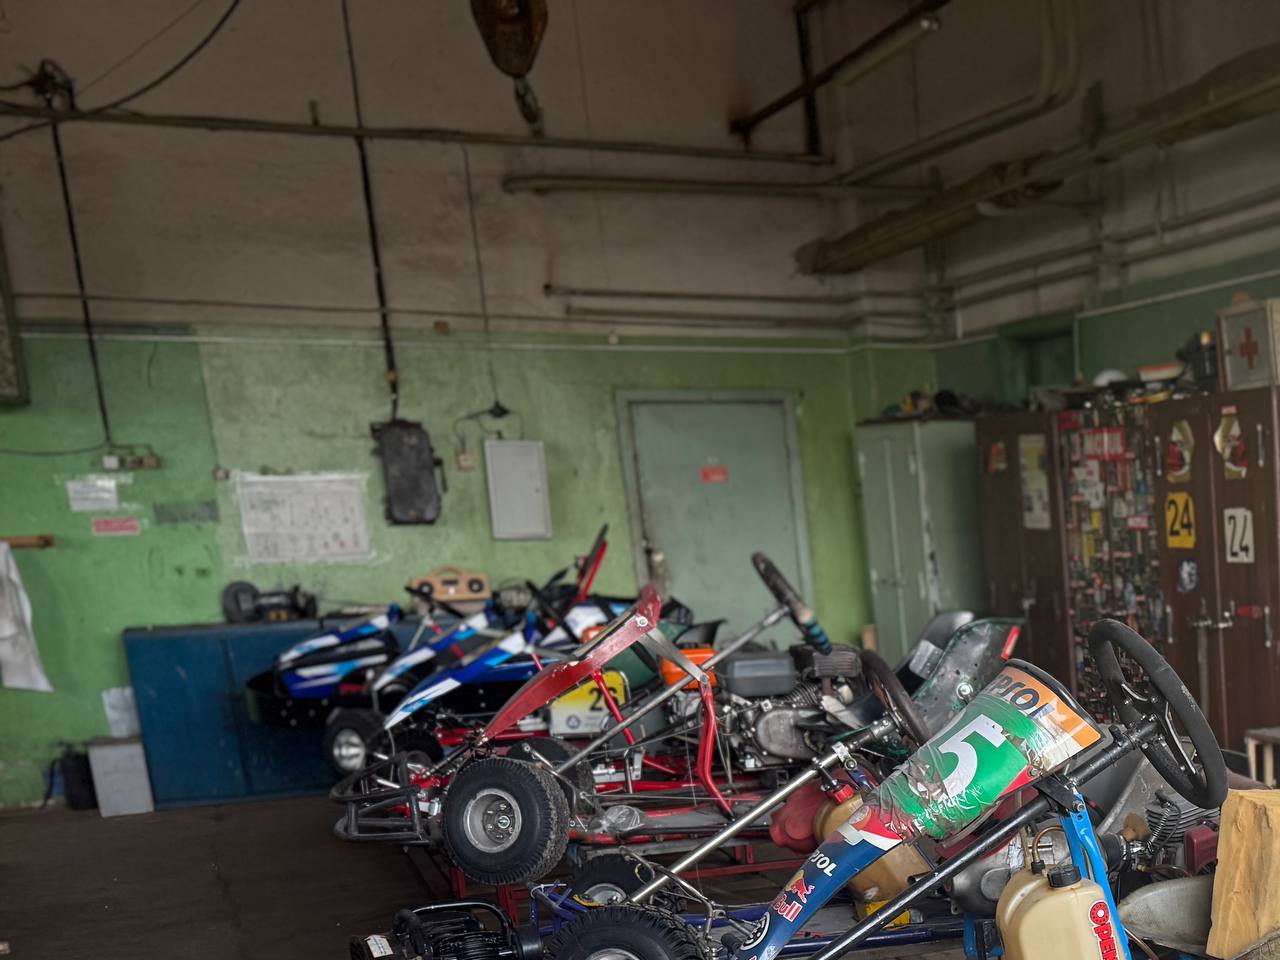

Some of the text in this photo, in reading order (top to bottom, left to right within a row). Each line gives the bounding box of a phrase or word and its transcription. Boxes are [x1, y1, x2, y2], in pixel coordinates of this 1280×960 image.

[1167, 498, 1193, 536] 24
[1228, 515, 1250, 557] 24
[909, 714, 1006, 799] 5
